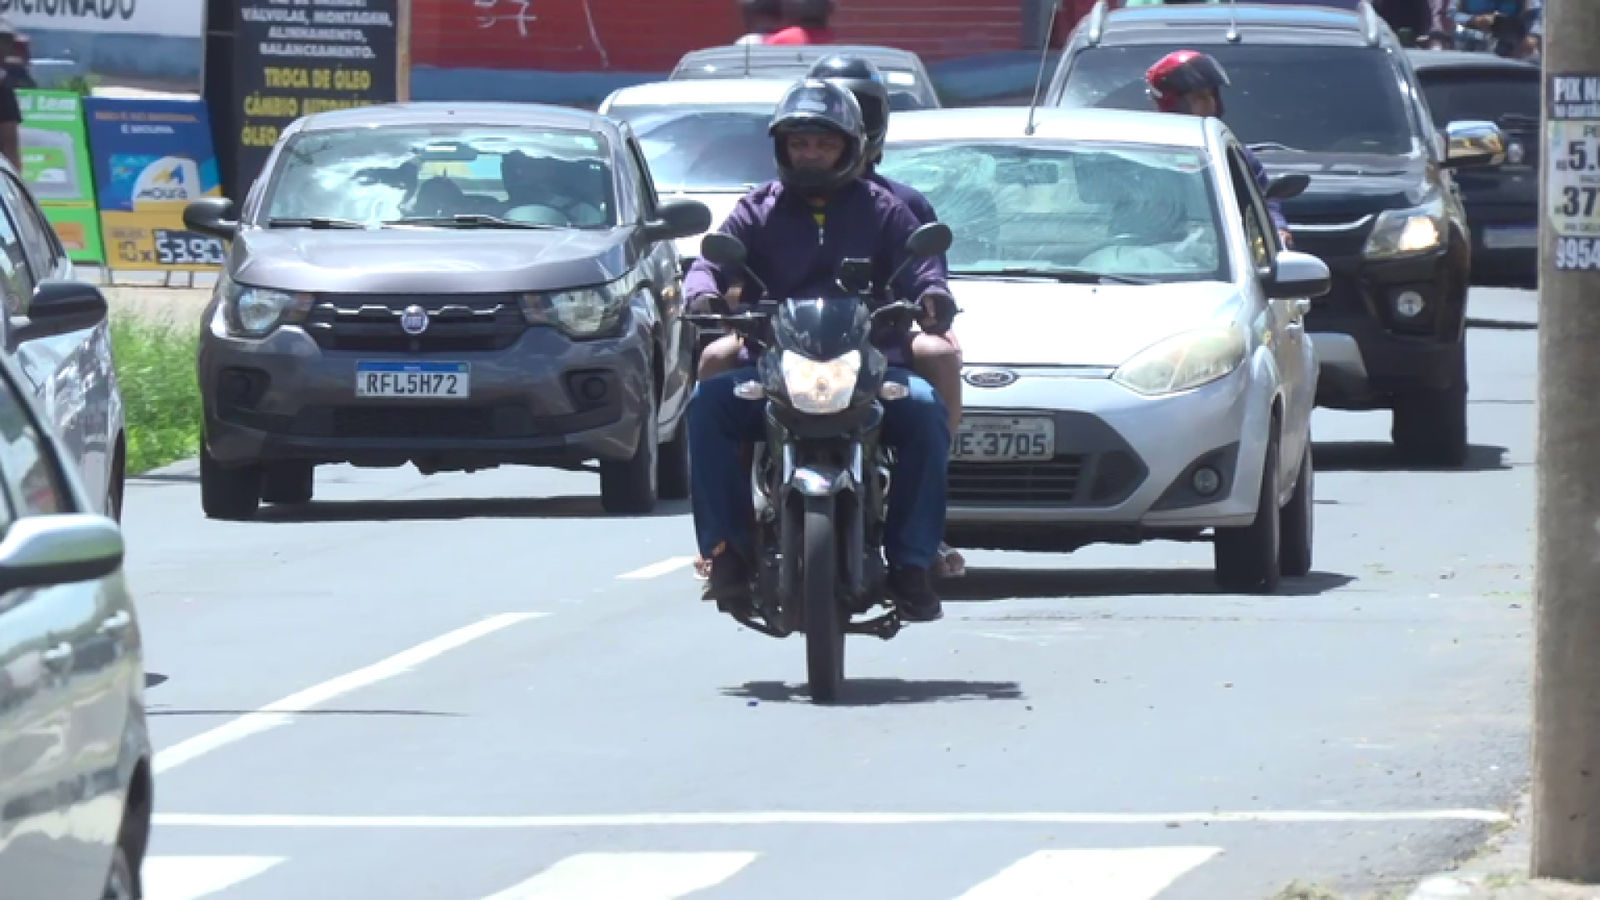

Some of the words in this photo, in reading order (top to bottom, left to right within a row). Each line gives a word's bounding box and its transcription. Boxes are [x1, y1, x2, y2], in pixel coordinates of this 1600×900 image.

[264, 67, 309, 88] TROCA
[312, 69, 332, 89] DE
[335, 64, 371, 90] ÓLEO
[244, 92, 298, 117] CÂMBIO
[241, 122, 278, 147] ÓLEO
[366, 374, 458, 394] RFL5H72
